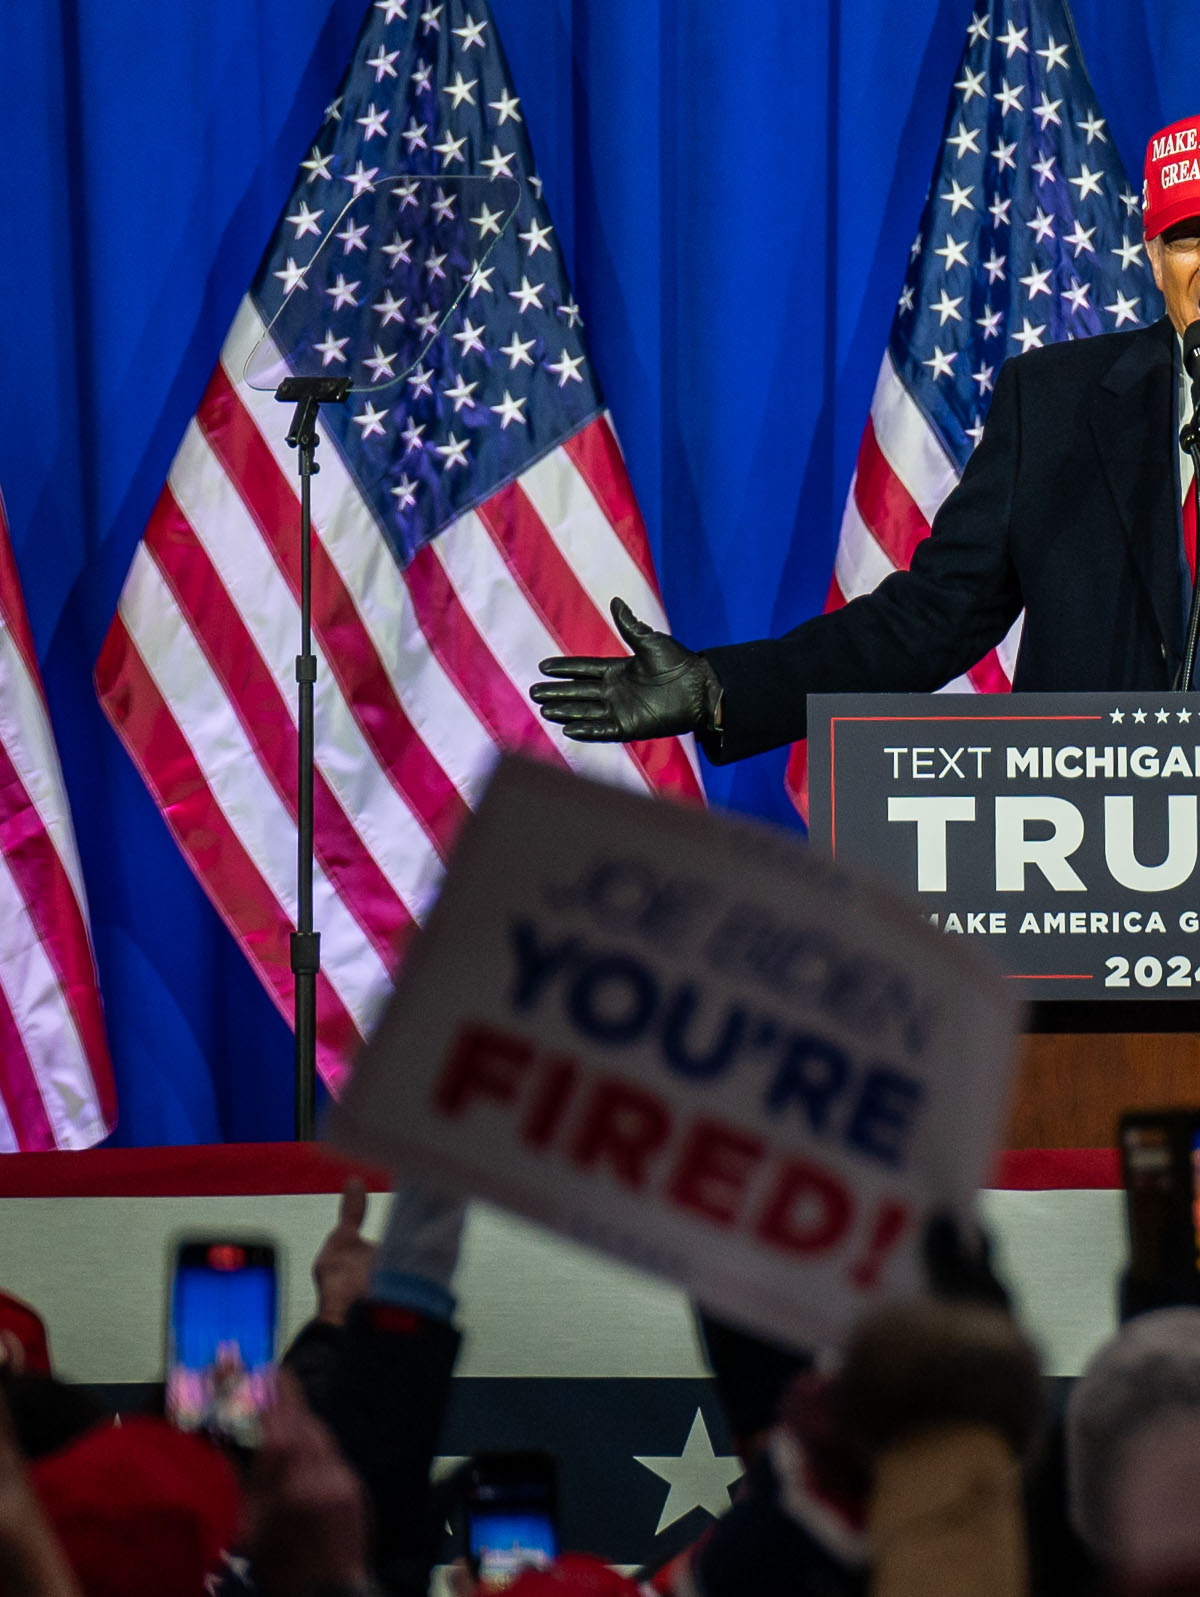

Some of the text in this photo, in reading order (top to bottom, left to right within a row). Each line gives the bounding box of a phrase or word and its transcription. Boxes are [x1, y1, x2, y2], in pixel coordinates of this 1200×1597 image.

[1152, 128, 1197, 162] MAKE
[884, 747, 991, 779] TEXT
[920, 912, 1007, 934] AKE
[1019, 911, 1166, 934] AMERICA
[506, 918, 932, 1172] YOU'RE
[430, 1016, 913, 1291] FIRED!
